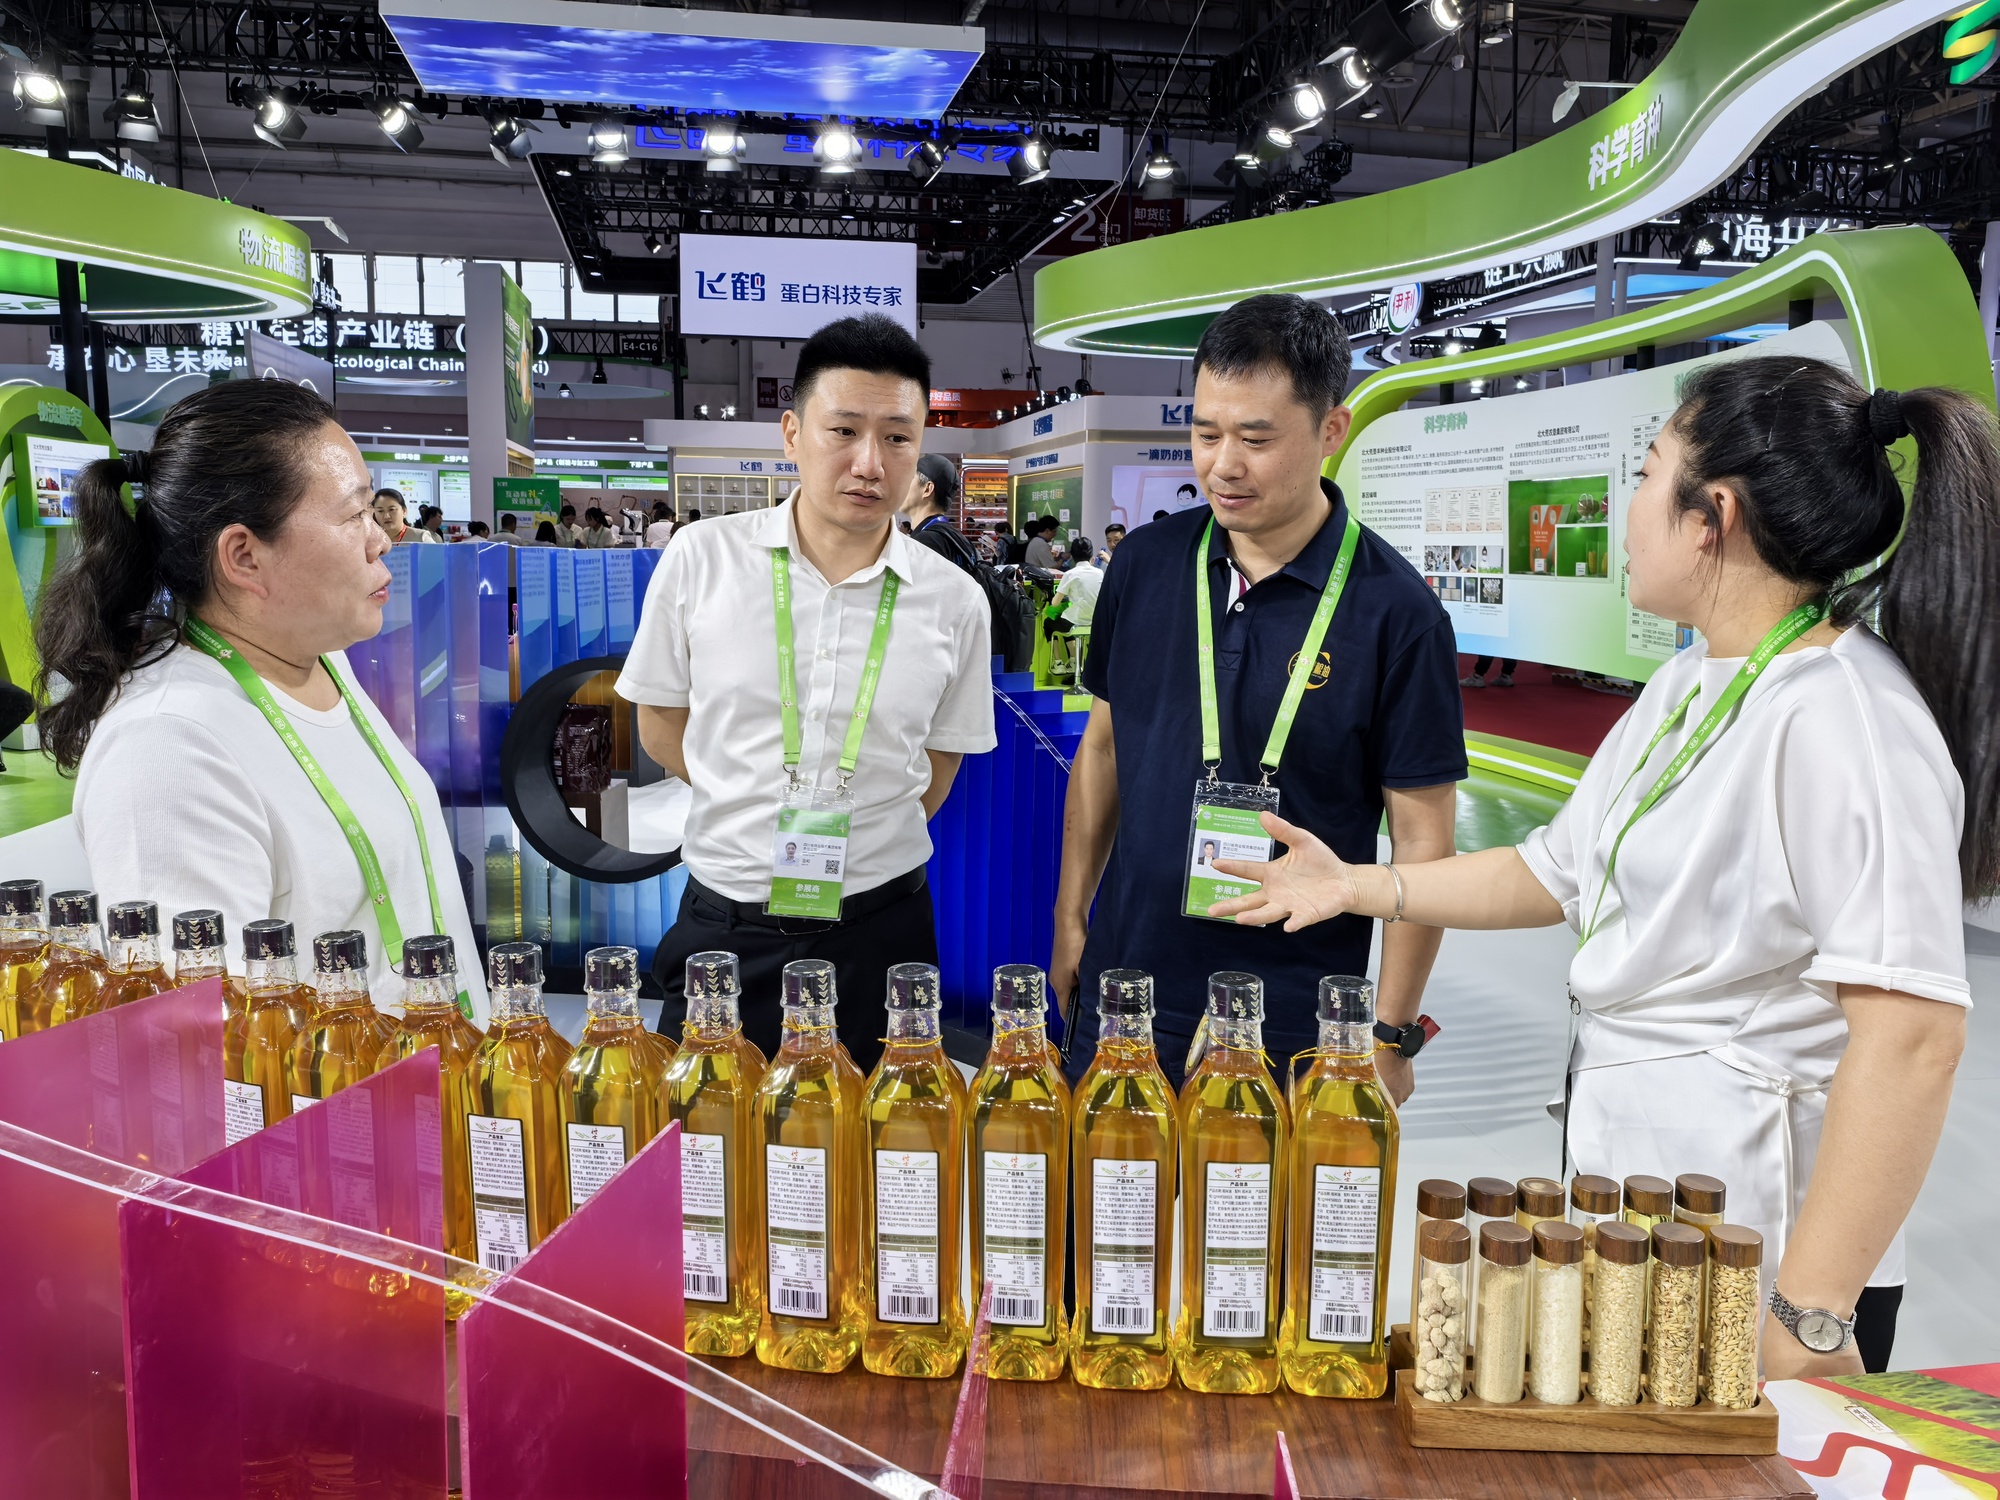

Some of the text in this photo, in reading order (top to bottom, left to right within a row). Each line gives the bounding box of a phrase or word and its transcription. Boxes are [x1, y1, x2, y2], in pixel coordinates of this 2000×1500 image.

[1588, 94, 1663, 191] 科学育种
[1071, 208, 1096, 242] 2
[1134, 207, 1171, 221] 卸货区
[1099, 235, 1121, 244] Gate
[1100, 223, 1120, 235] 号门
[239, 228, 307, 282] 物流服务
[695, 270, 902, 307] 飞鹤 蛋白科技专家
[1392, 291, 1415, 317] 伊利
[623, 341, 658, 351] E4-C16
[145, 347, 230, 373] 垦未来
[418, 357, 464, 372] Chain
[1424, 411, 1468, 434] 科学育种
[739, 461, 763, 472] 飞鹤
[1328, 556, 1347, 593] 中国工商银行
[1318, 606, 1329, 623] ICBC
[258, 695, 321, 780] ICBC 中国工商银行
[1650, 715, 1716, 798] ICBC 中国工商银行
[796, 883, 821, 894] 参展商
[1214, 884, 1242, 896] 参展商
